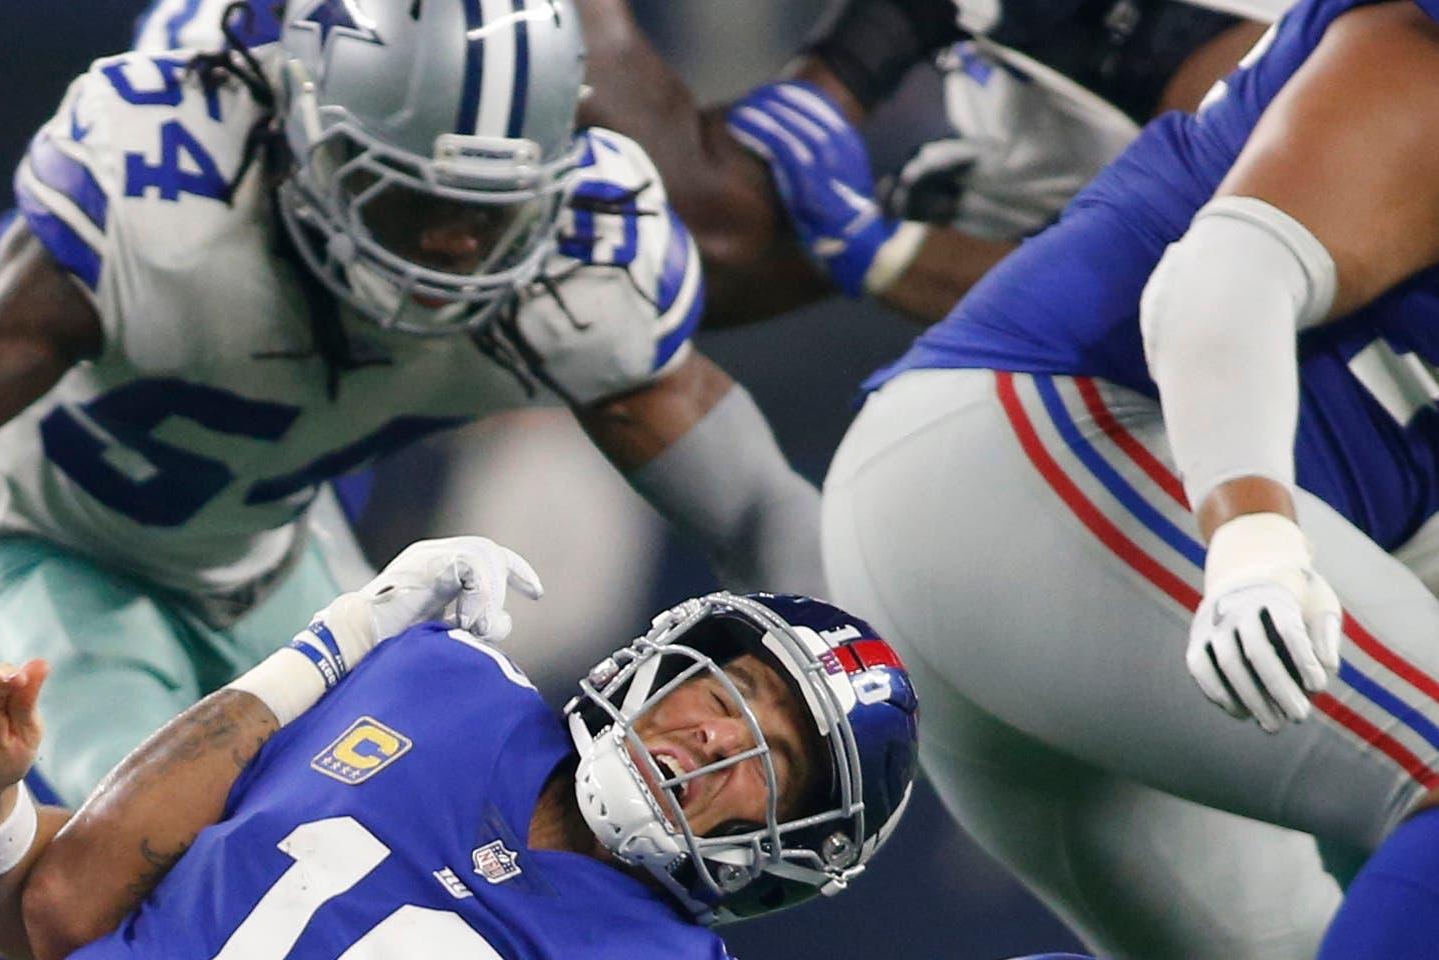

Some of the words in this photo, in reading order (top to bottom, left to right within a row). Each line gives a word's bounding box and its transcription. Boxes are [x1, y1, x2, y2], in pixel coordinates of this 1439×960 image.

[102, 57, 234, 204] 54
[818, 623, 892, 706] 10
[332, 725, 400, 770] C
